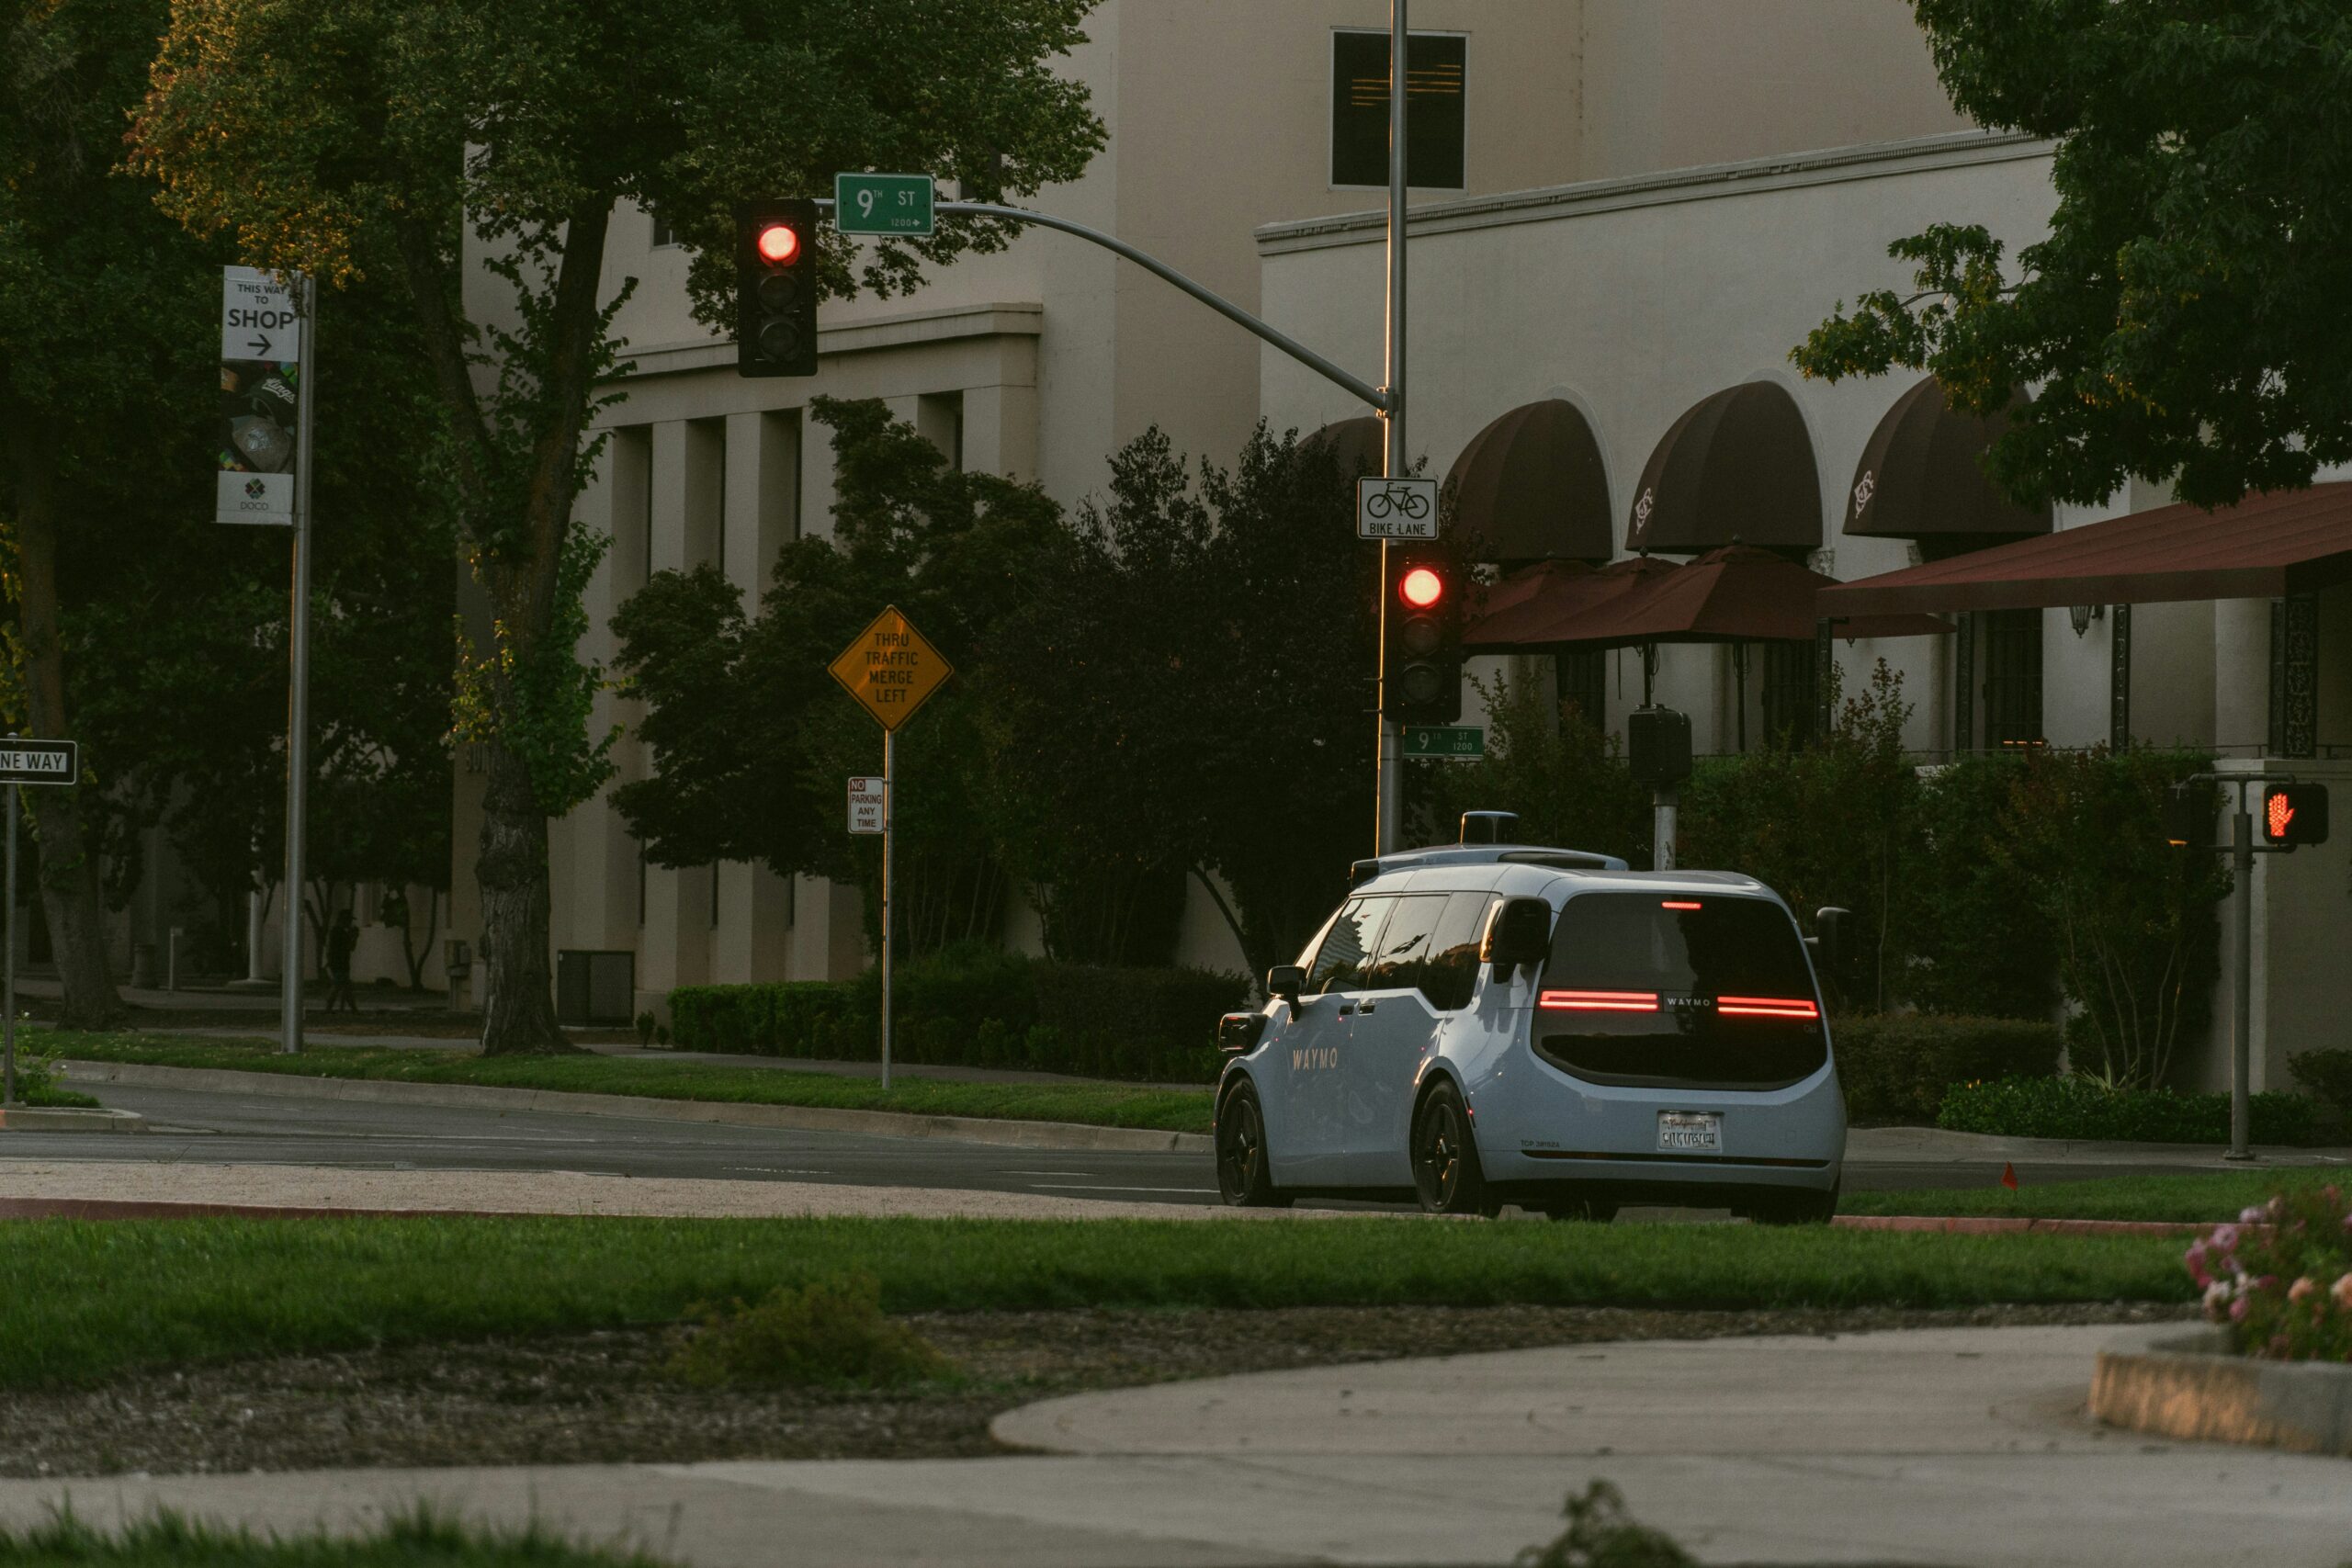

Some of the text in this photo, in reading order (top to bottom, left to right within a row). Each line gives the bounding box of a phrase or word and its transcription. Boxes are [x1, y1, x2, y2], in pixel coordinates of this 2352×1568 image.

[898, 191, 915, 206] ST
[891, 219, 911, 227] 1200
[238, 284, 286, 295] THIS WAY
[254, 295, 268, 305] TO
[227, 309, 295, 330] SHOP
[1370, 523, 1426, 535] BIKE LANE
[875, 633, 909, 647] THRU
[865, 651, 919, 665] TRAFFIC
[869, 671, 913, 684] MERGE
[876, 690, 907, 703] LEFT
[1458, 732, 1468, 740] ST
[1453, 742, 1473, 750] 1200
[0, 753, 62, 770] NE WAY
[851, 780, 865, 790] NO
[851, 794, 882, 804] PARKING
[858, 807, 876, 816] ANY
[857, 818, 876, 828] TIME
[1668, 998, 1711, 1007] WAYMO
[1294, 1047, 1338, 1070] WAYMO
